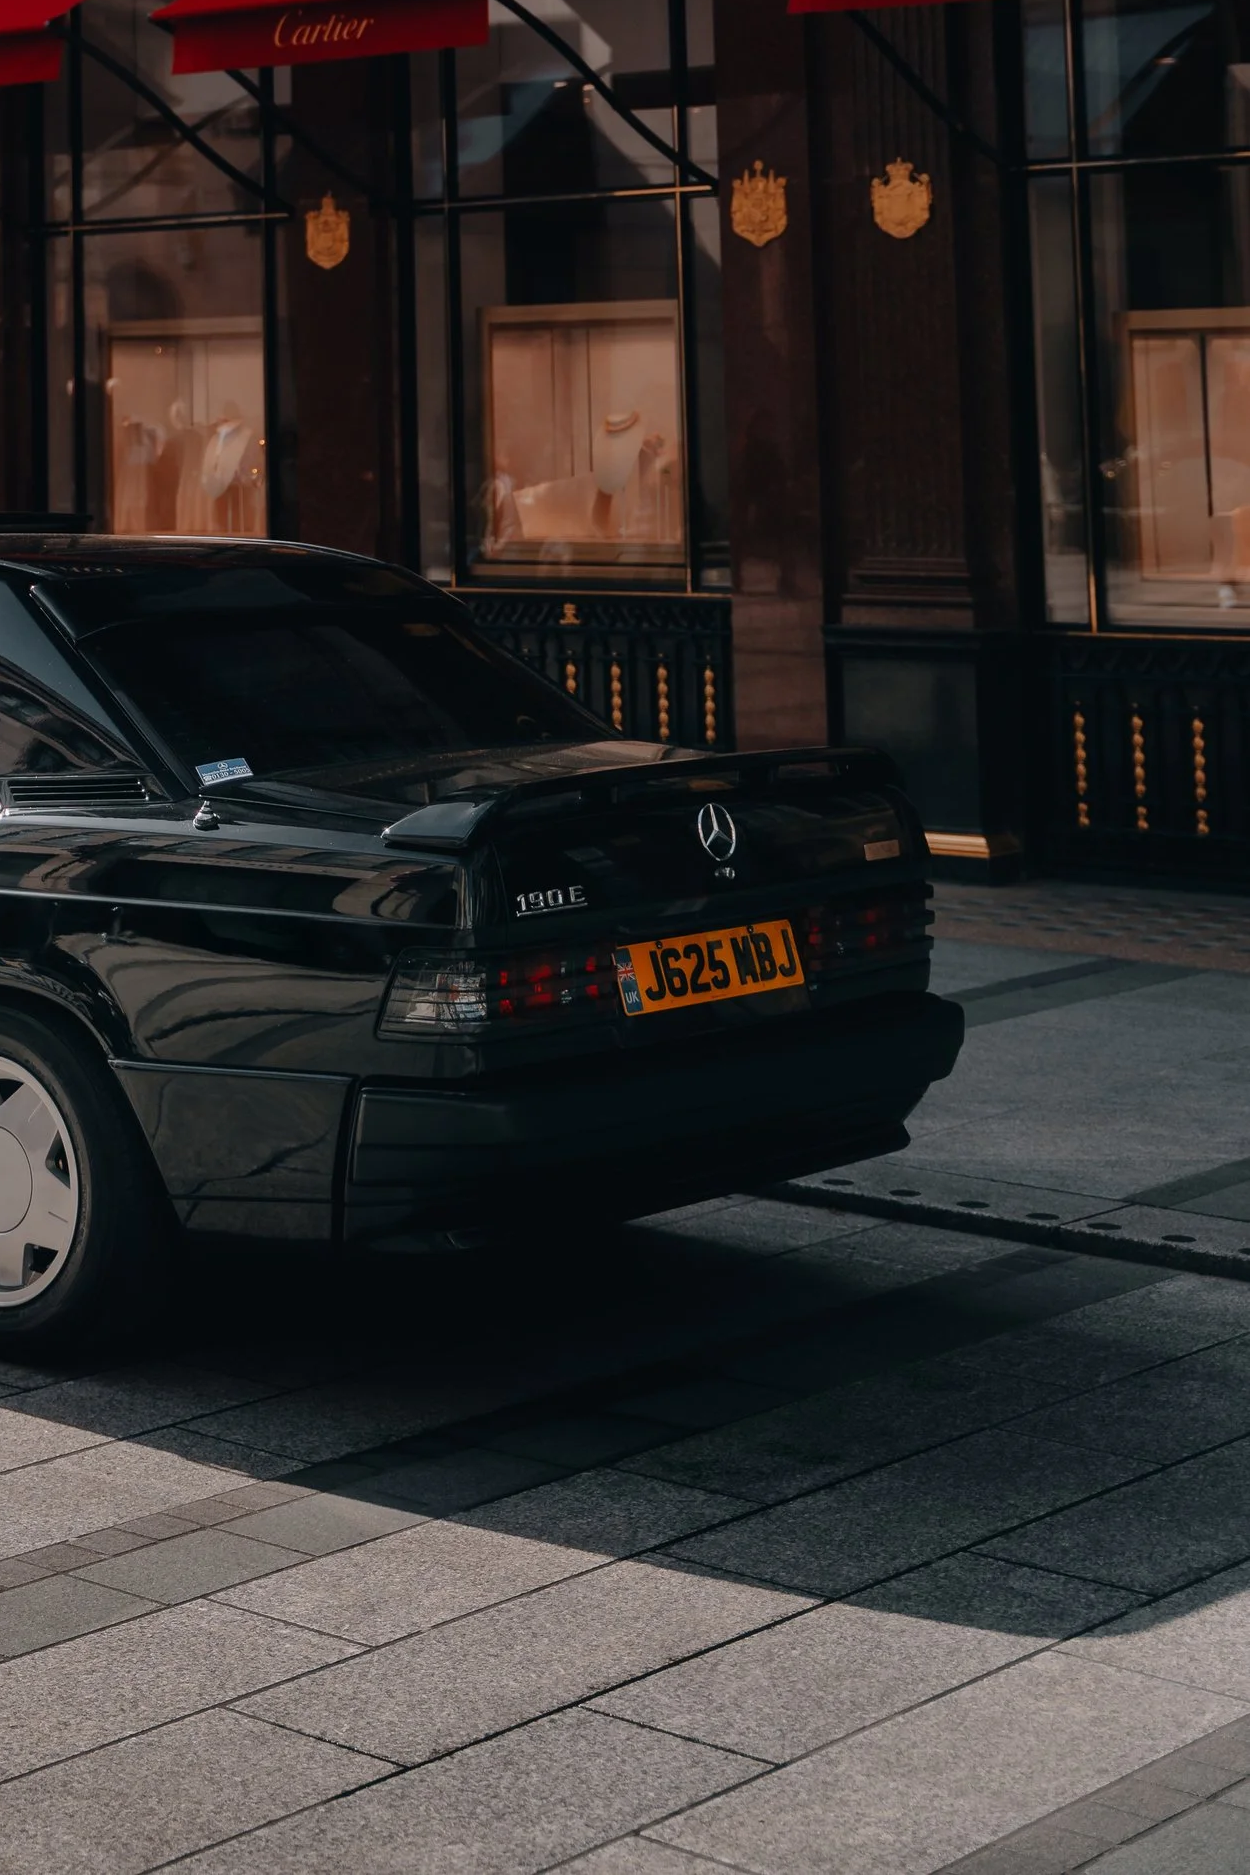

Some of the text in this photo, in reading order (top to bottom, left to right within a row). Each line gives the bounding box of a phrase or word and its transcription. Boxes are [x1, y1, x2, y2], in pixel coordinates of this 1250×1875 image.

[274, 11, 374, 49] Cartier
[516, 885, 586, 911] 190 E
[645, 939, 730, 1001] J625
[624, 990, 639, 1004] UK
